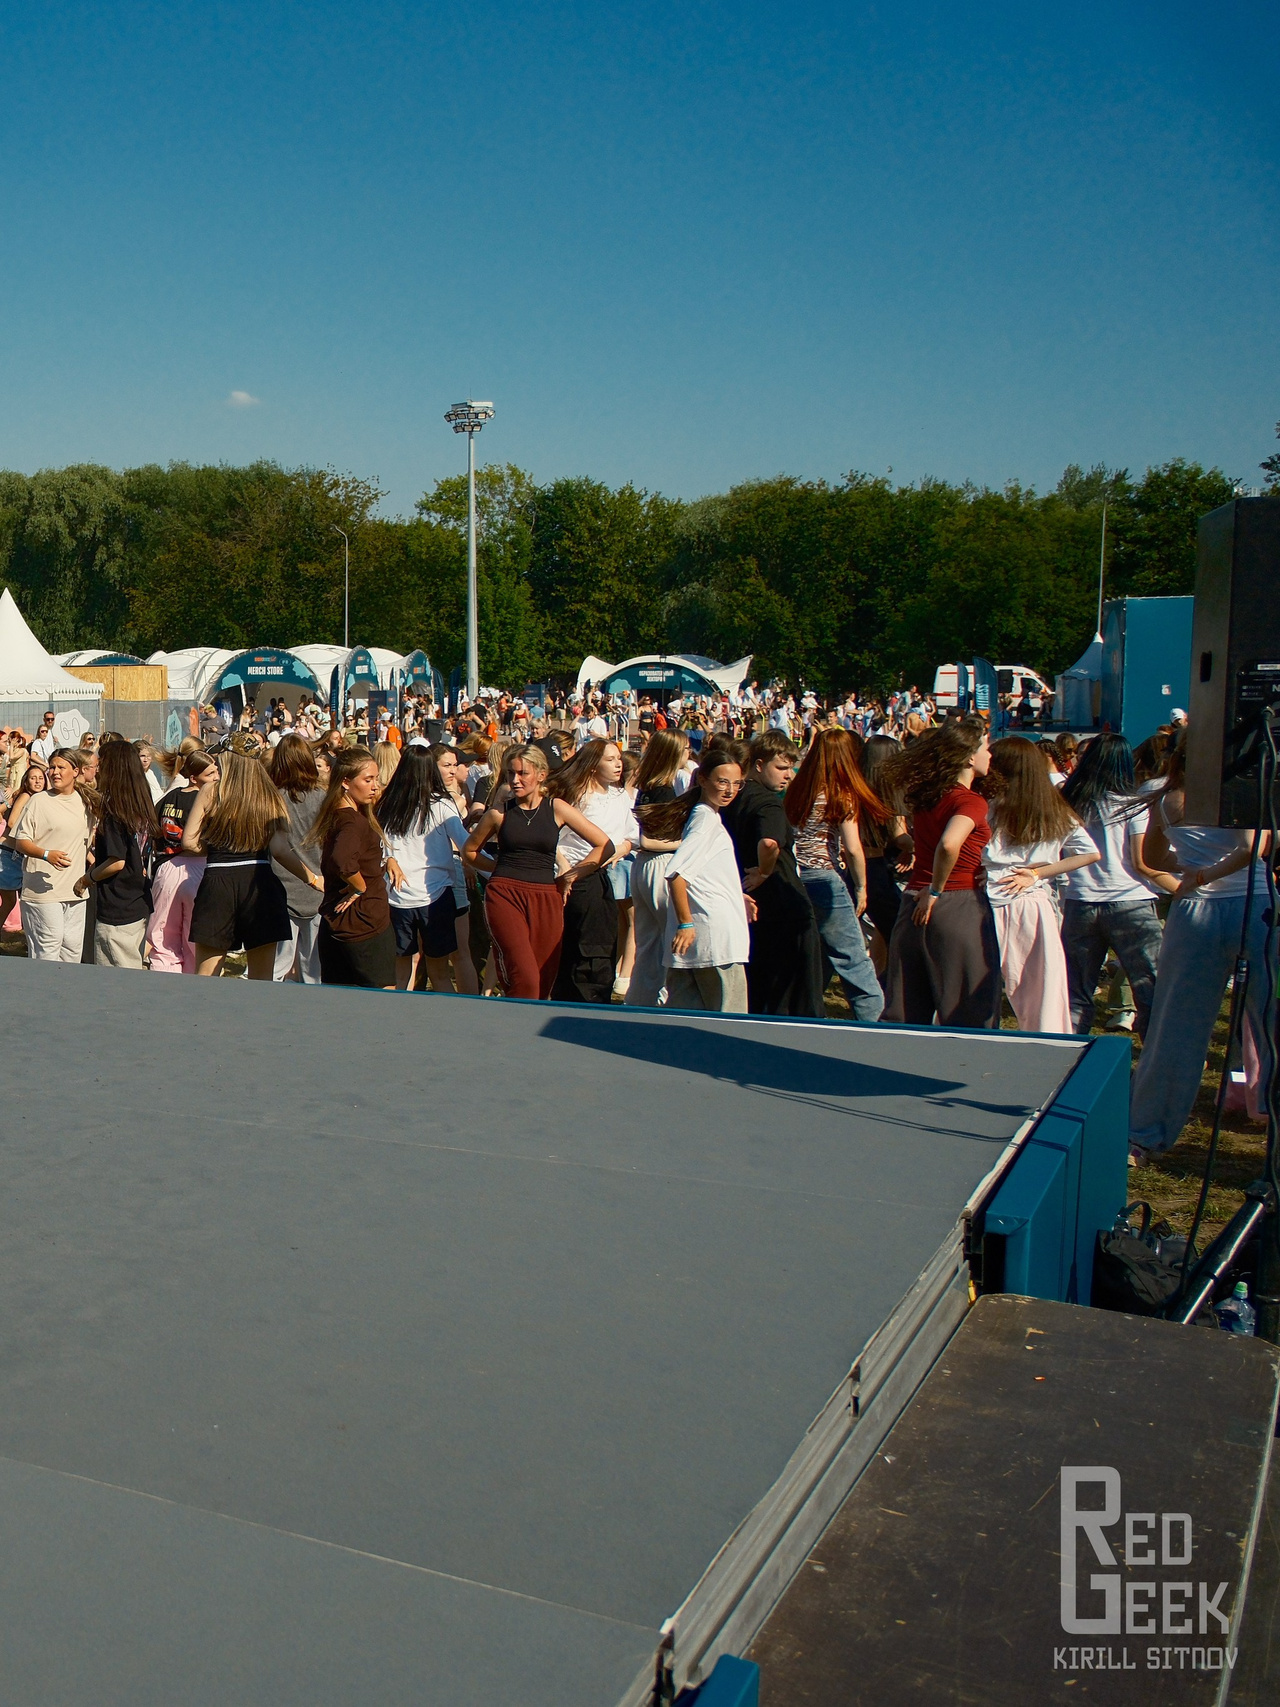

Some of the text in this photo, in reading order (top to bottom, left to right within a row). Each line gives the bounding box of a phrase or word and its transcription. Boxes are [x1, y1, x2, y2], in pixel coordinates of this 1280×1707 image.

[247, 666, 284, 675] MERCH STORE
[975, 683, 989, 709] FITNESS
